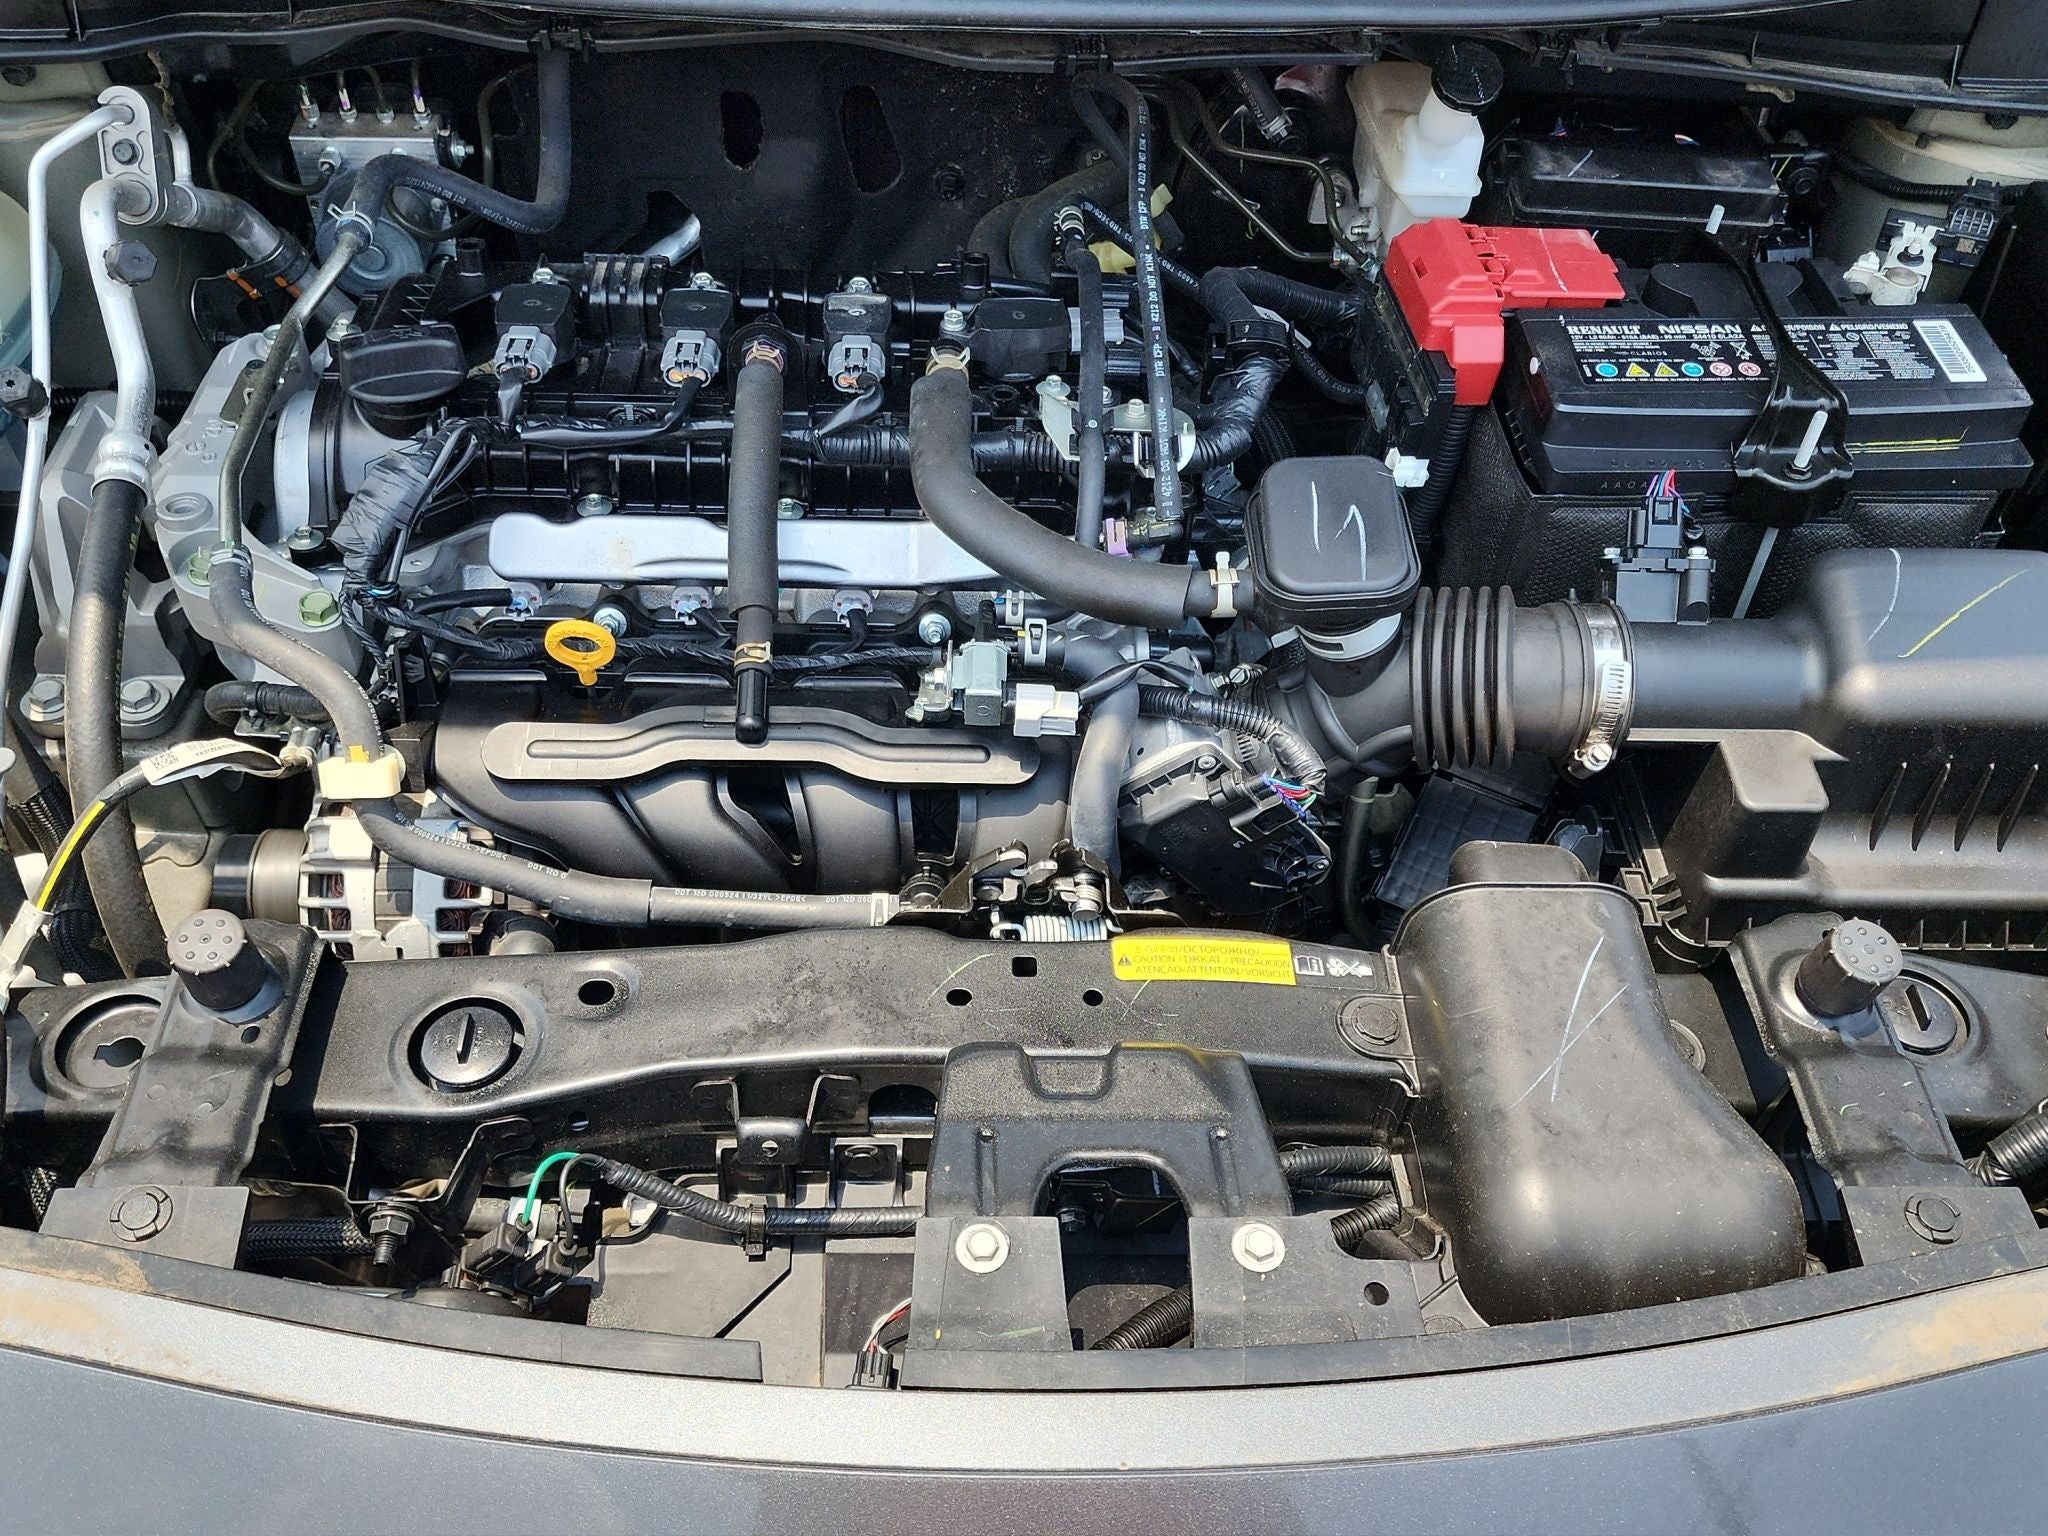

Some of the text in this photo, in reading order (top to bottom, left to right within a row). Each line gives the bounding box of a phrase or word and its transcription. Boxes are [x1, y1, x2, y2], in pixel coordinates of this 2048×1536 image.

[1566, 324, 1742, 335] RENAULT NISSAN
[1132, 955, 1175, 963] CAUTION
[1183, 955, 1220, 964] DIKKAT
